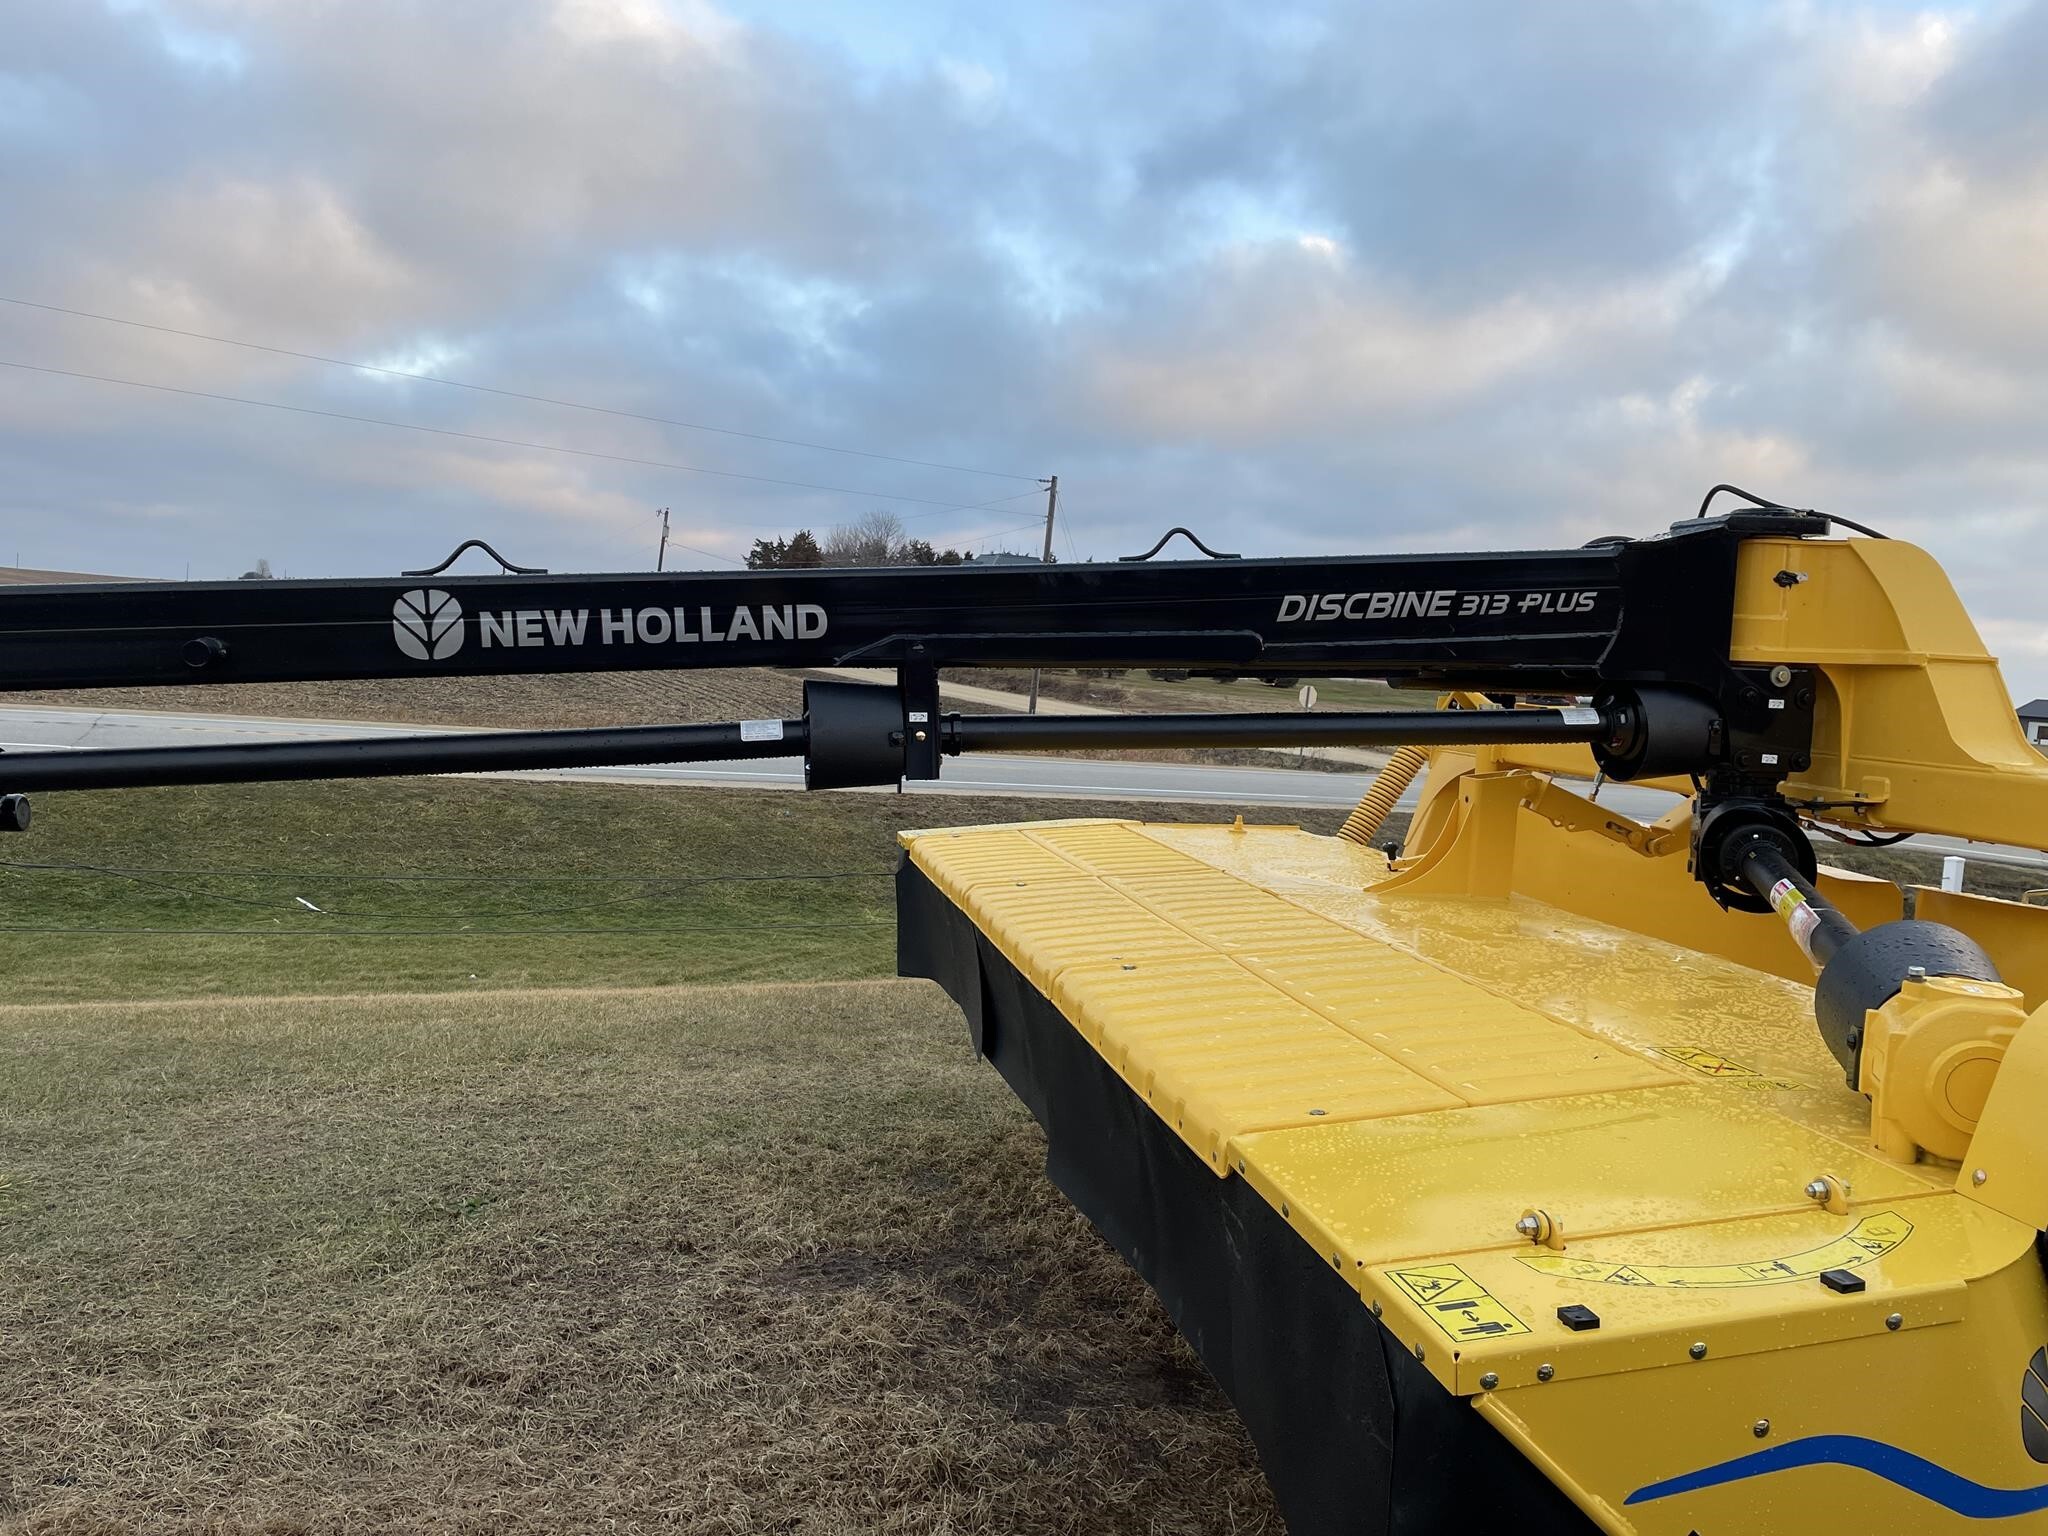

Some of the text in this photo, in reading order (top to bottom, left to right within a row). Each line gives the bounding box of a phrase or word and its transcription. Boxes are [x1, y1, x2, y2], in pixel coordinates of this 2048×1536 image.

[1277, 590, 1457, 622] DISCBINE
[1458, 594, 1510, 616] 313
[479, 604, 828, 647] NEW HOLLAND
